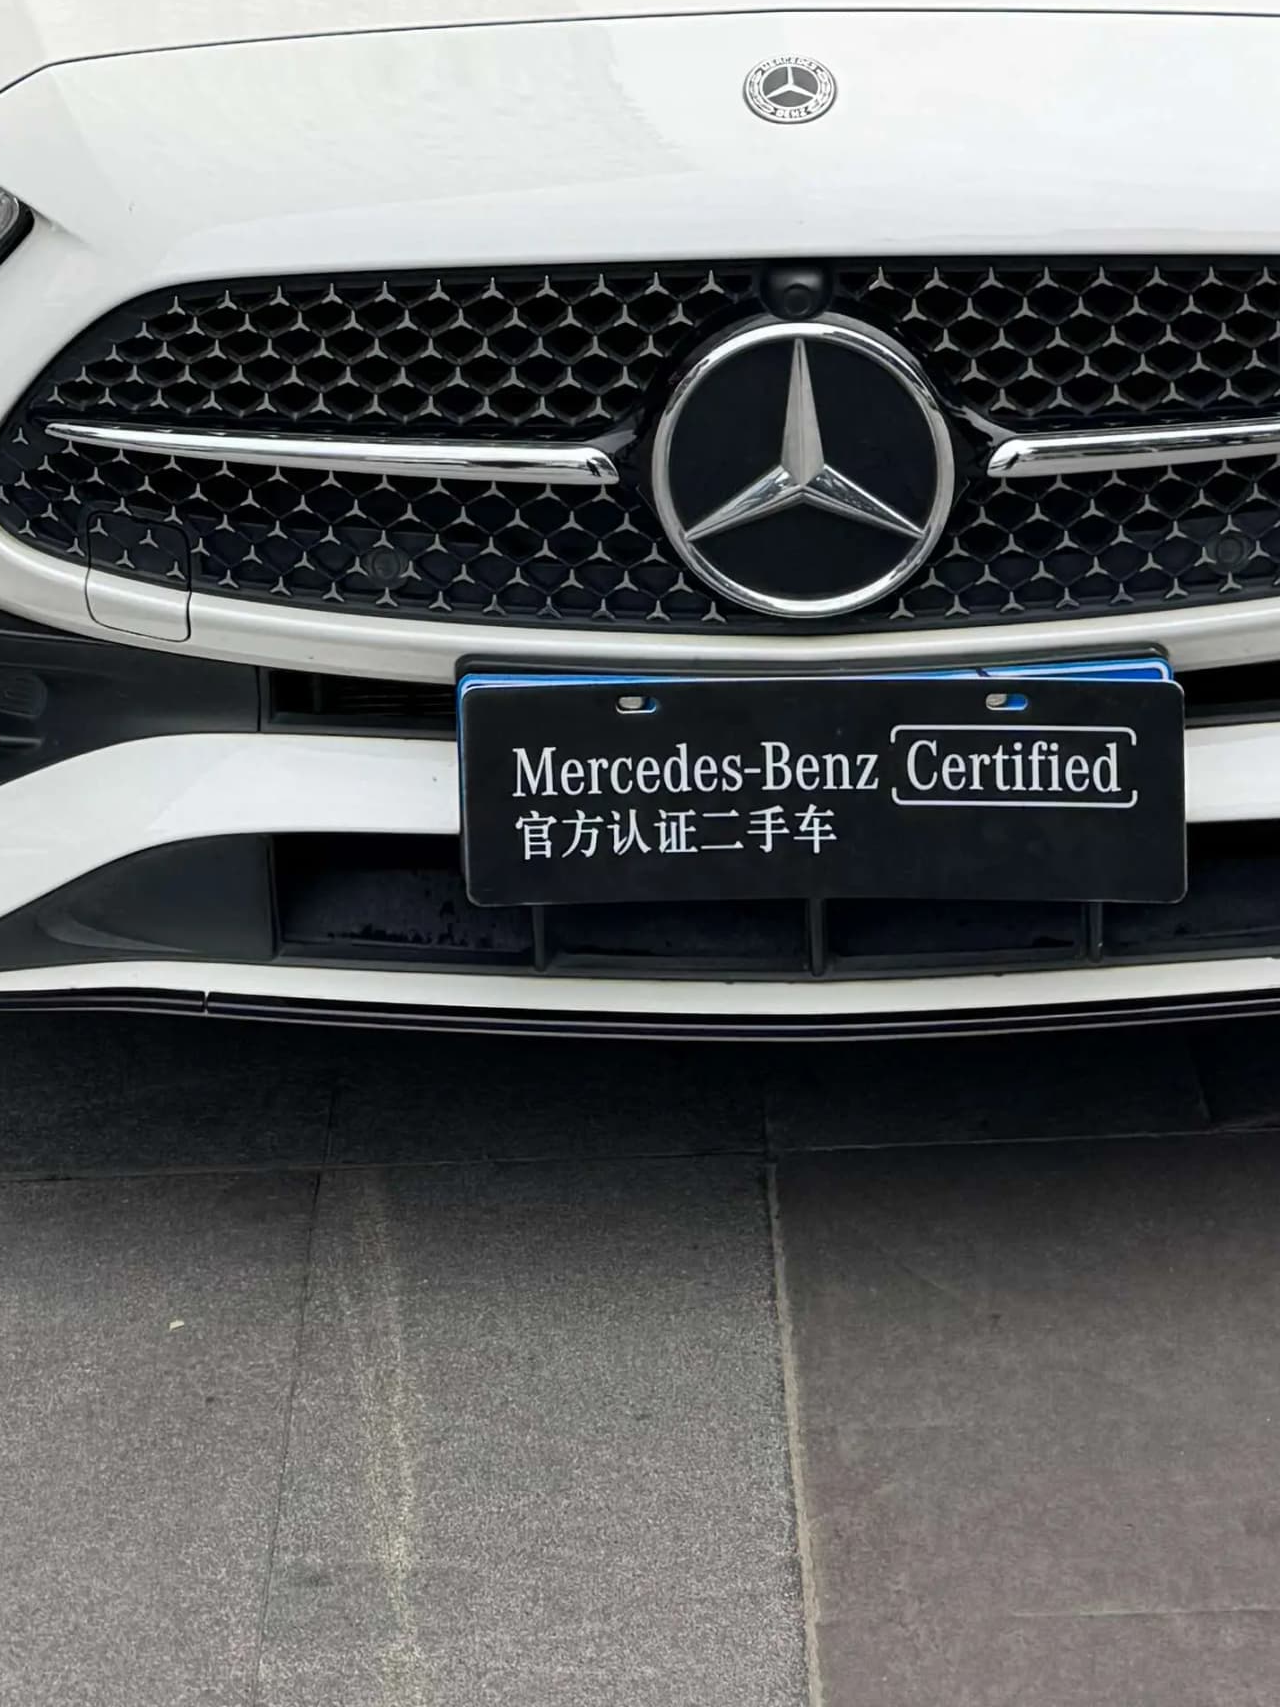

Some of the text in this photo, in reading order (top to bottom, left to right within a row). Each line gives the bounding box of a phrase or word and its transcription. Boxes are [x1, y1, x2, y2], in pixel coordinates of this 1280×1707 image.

[512, 739, 1122, 797] Mercedes-Benz Certified
[515, 803, 837, 861] 官方认证二手车
